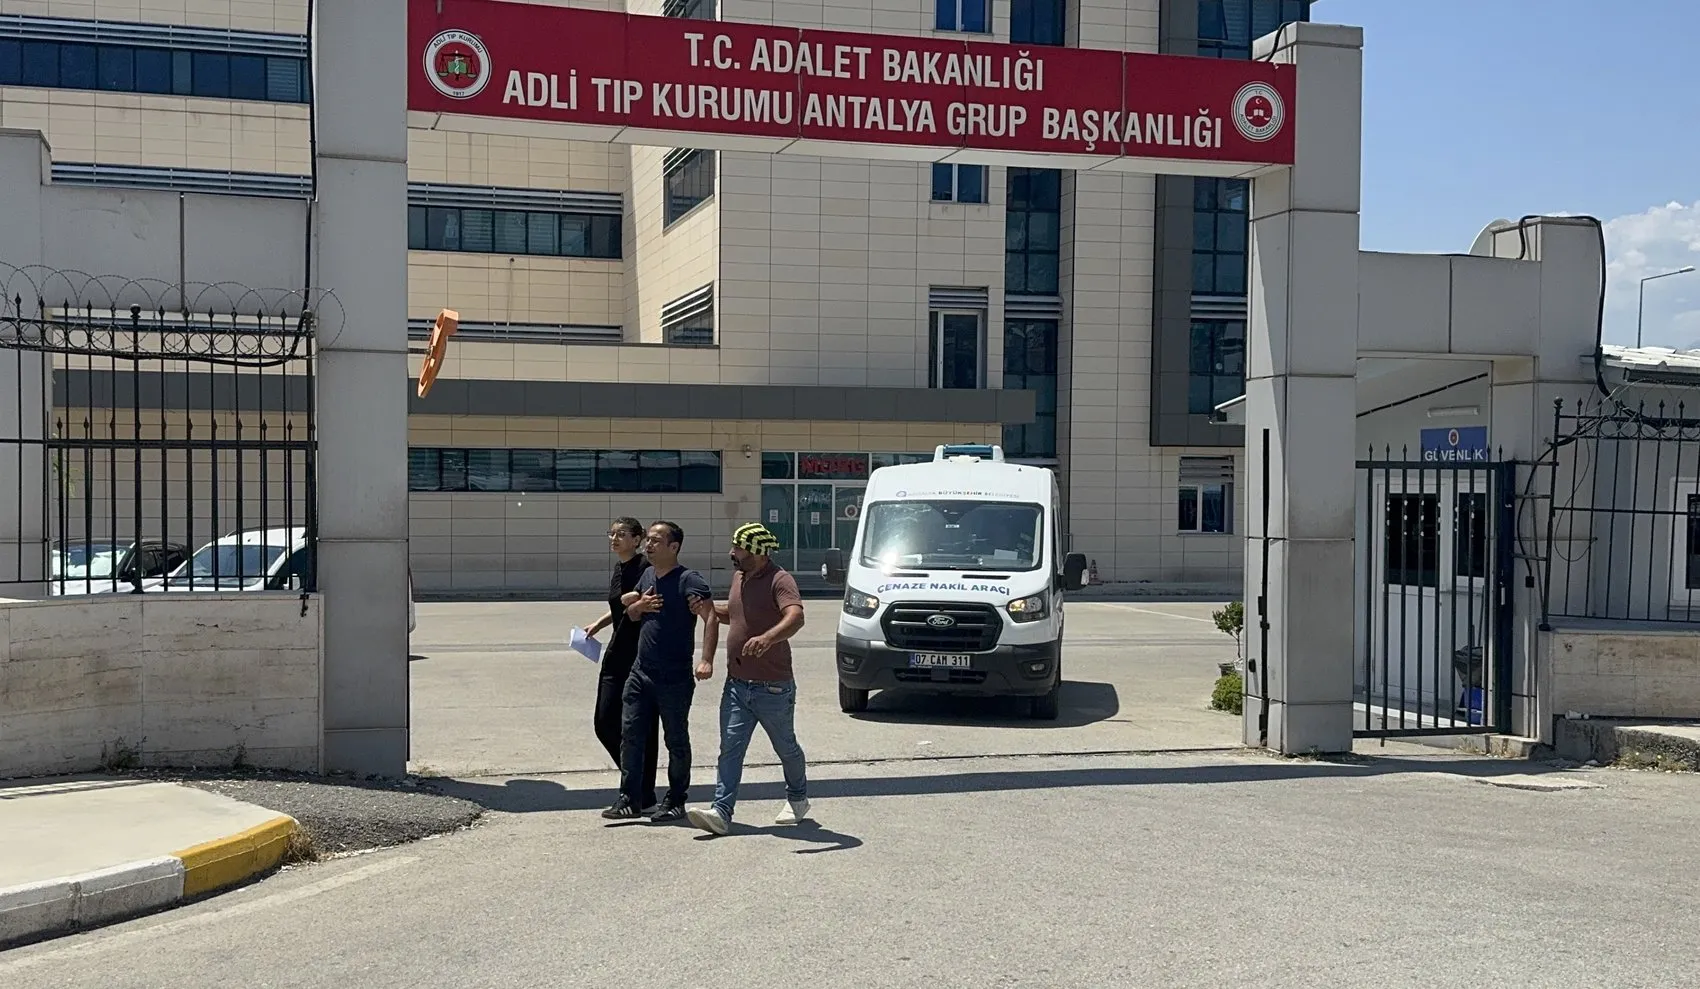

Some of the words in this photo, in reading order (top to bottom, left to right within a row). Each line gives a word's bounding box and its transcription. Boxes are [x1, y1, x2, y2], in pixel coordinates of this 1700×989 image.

[459, 34, 483, 53] KURUMU
[685, 33, 741, 70] T.C.
[750, 39, 871, 80] ADALET
[884, 49, 1043, 91] BAKANLIĞI
[503, 68, 577, 110] ADLİ
[592, 78, 643, 114] TIP
[653, 83, 793, 125] KURUMU
[804, 94, 937, 133] ANTALYA
[947, 103, 1027, 137] GRUP
[1043, 107, 1222, 151] BAŞKANLIĞI
[1424, 447, 1484, 461] GÜVENLK
[877, 582, 926, 594] CENAZE
[930, 582, 967, 591] NAKİL
[915, 654, 927, 665] 07
[930, 655, 948, 665] CAM
[951, 655, 968, 666] 311
